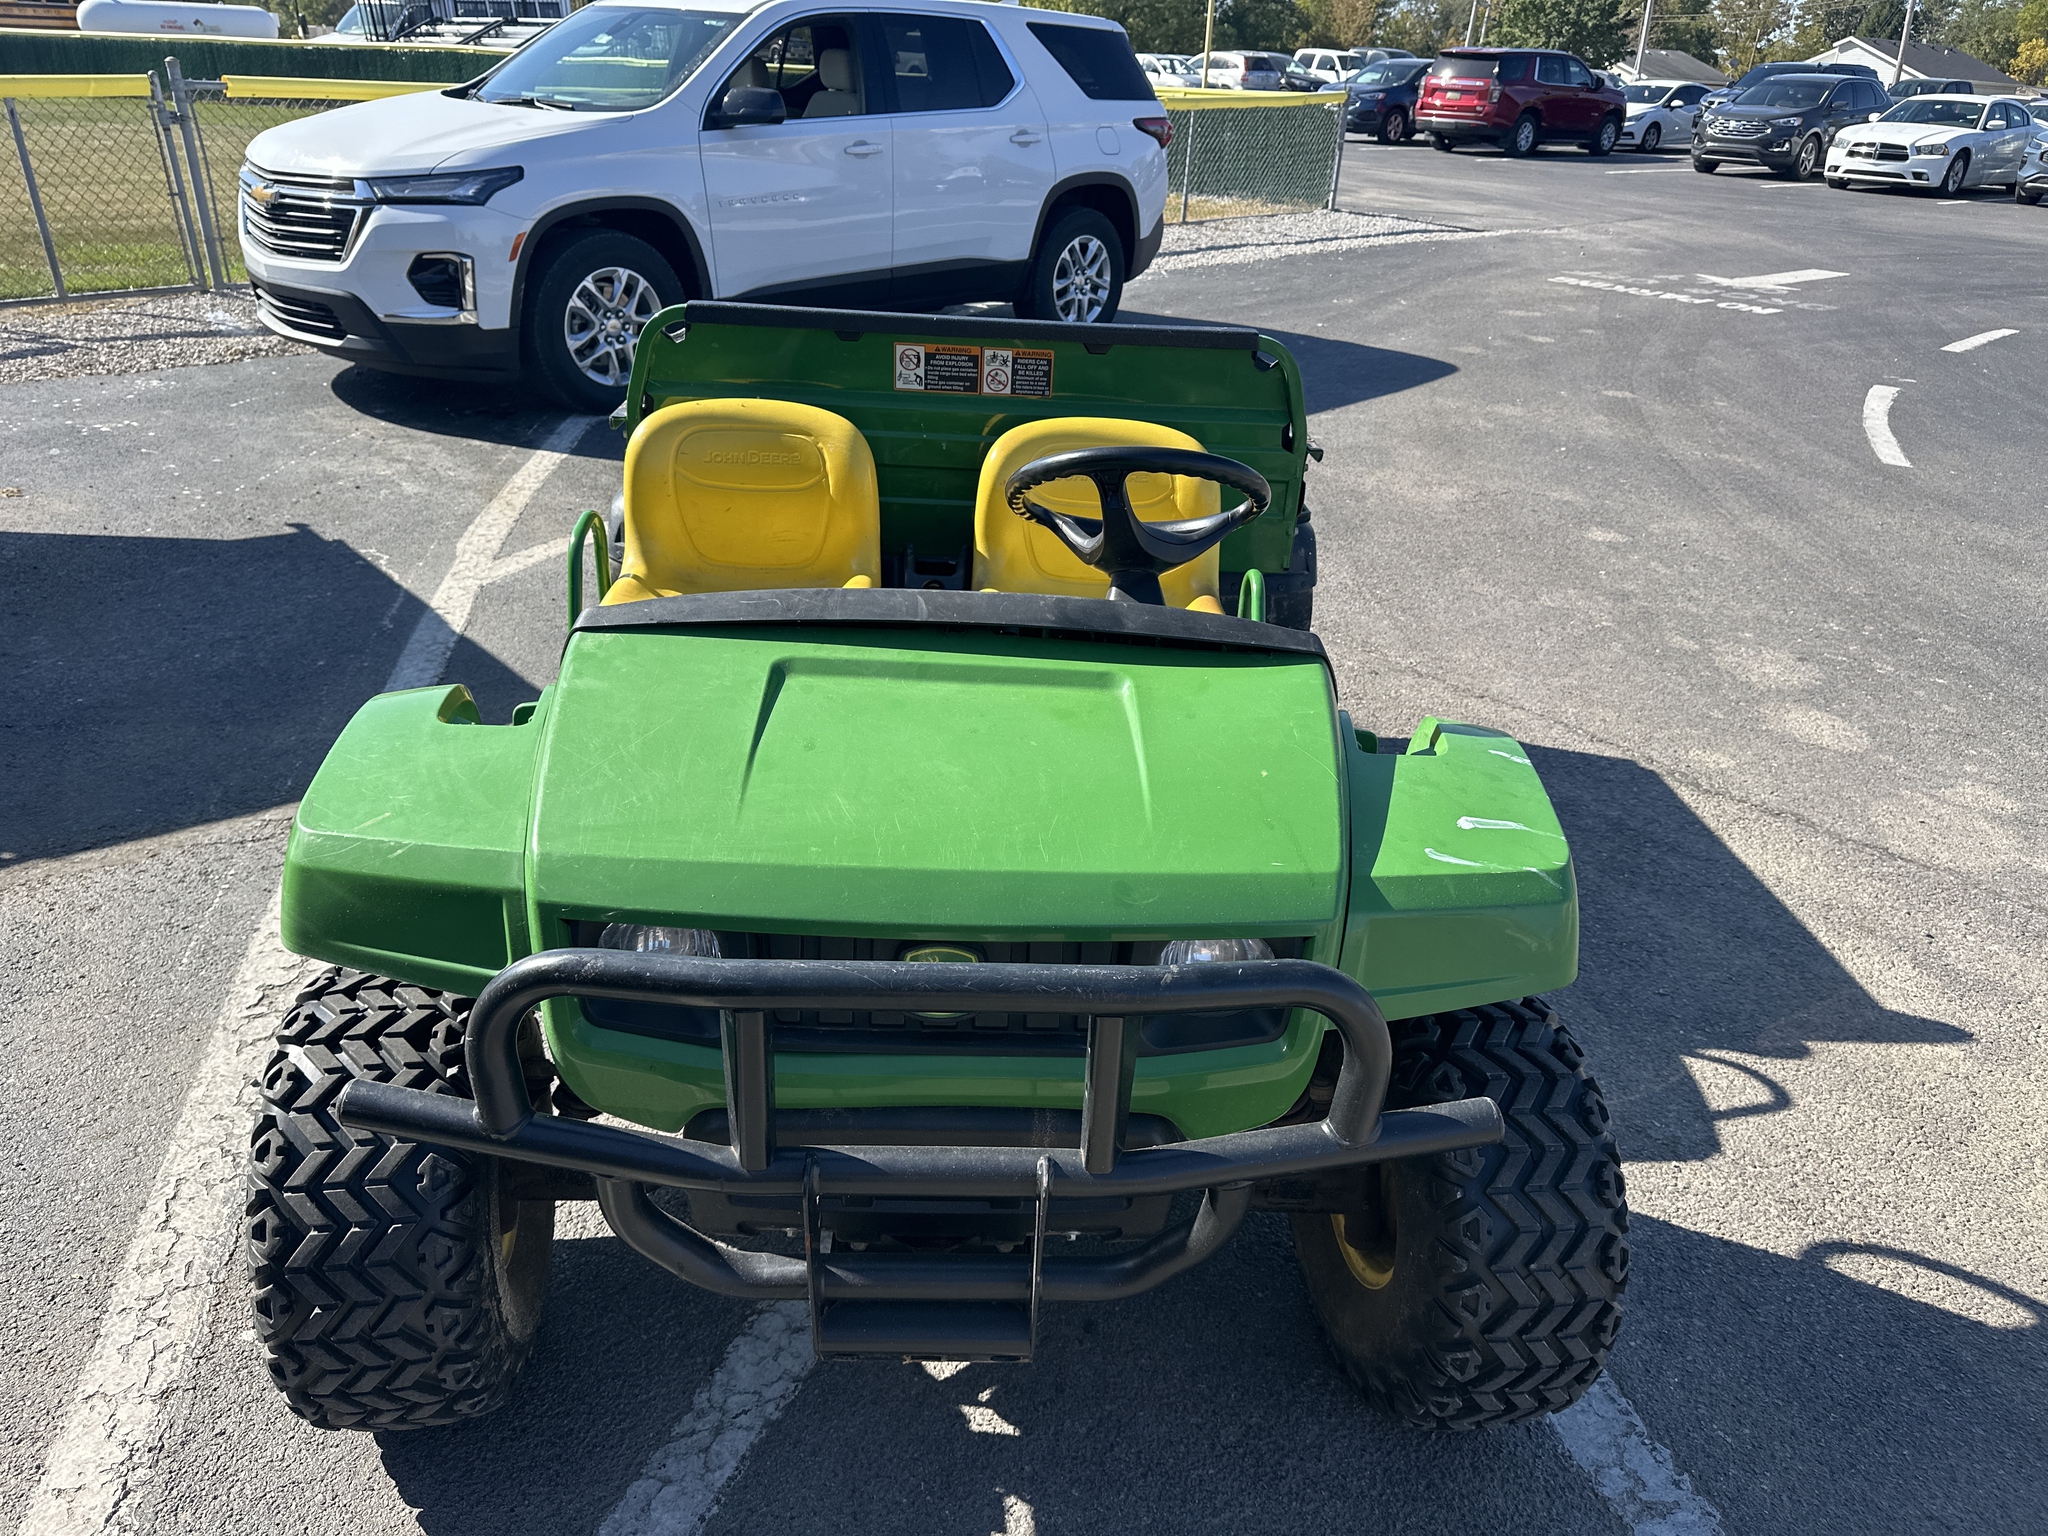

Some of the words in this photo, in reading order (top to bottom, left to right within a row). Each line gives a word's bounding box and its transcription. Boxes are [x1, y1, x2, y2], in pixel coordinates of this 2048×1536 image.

[1547, 276, 1715, 304] PARKING
[1716, 302, 1784, 314] NO
[702, 450, 745, 464] JOHN
[747, 450, 801, 465] DEERE
